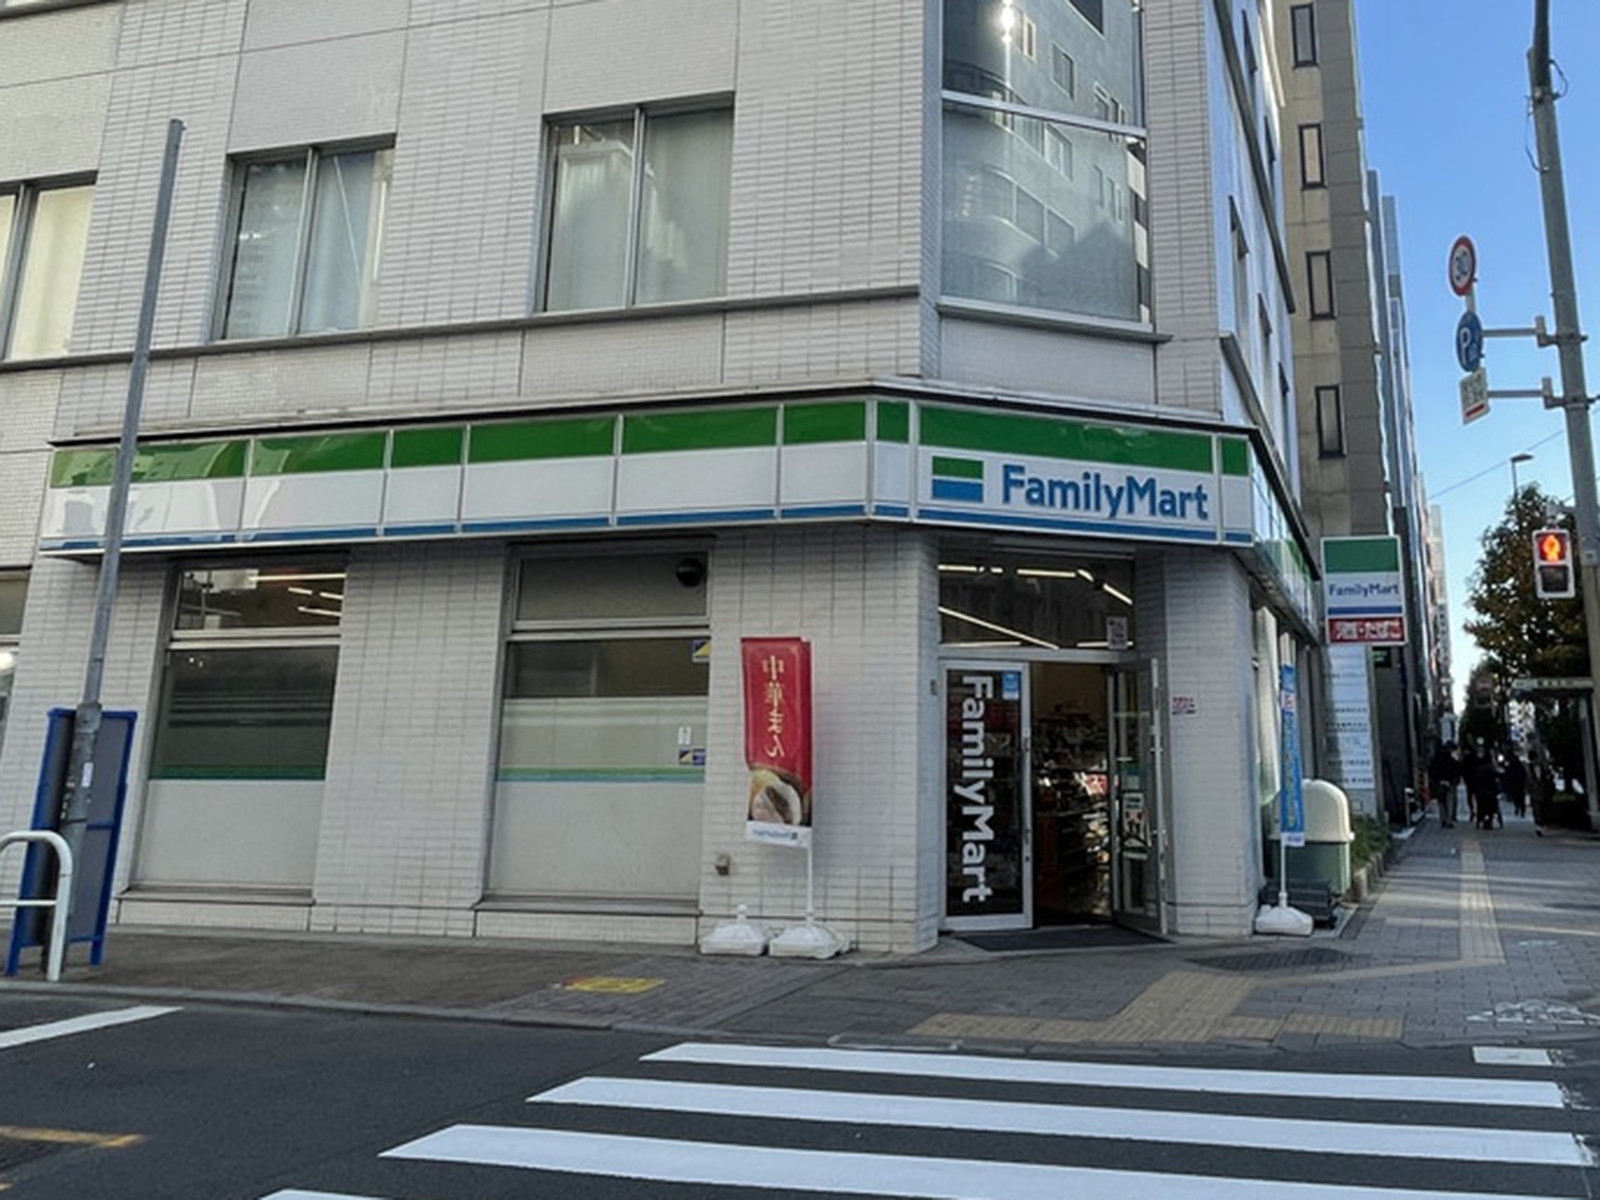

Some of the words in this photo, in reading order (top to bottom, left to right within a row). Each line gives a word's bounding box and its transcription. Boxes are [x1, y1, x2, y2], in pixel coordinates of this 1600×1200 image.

[1002, 463, 1209, 520] FamilyMart
[1328, 583, 1399, 598] FamilyMart
[953, 675, 994, 902] FamilyMart
